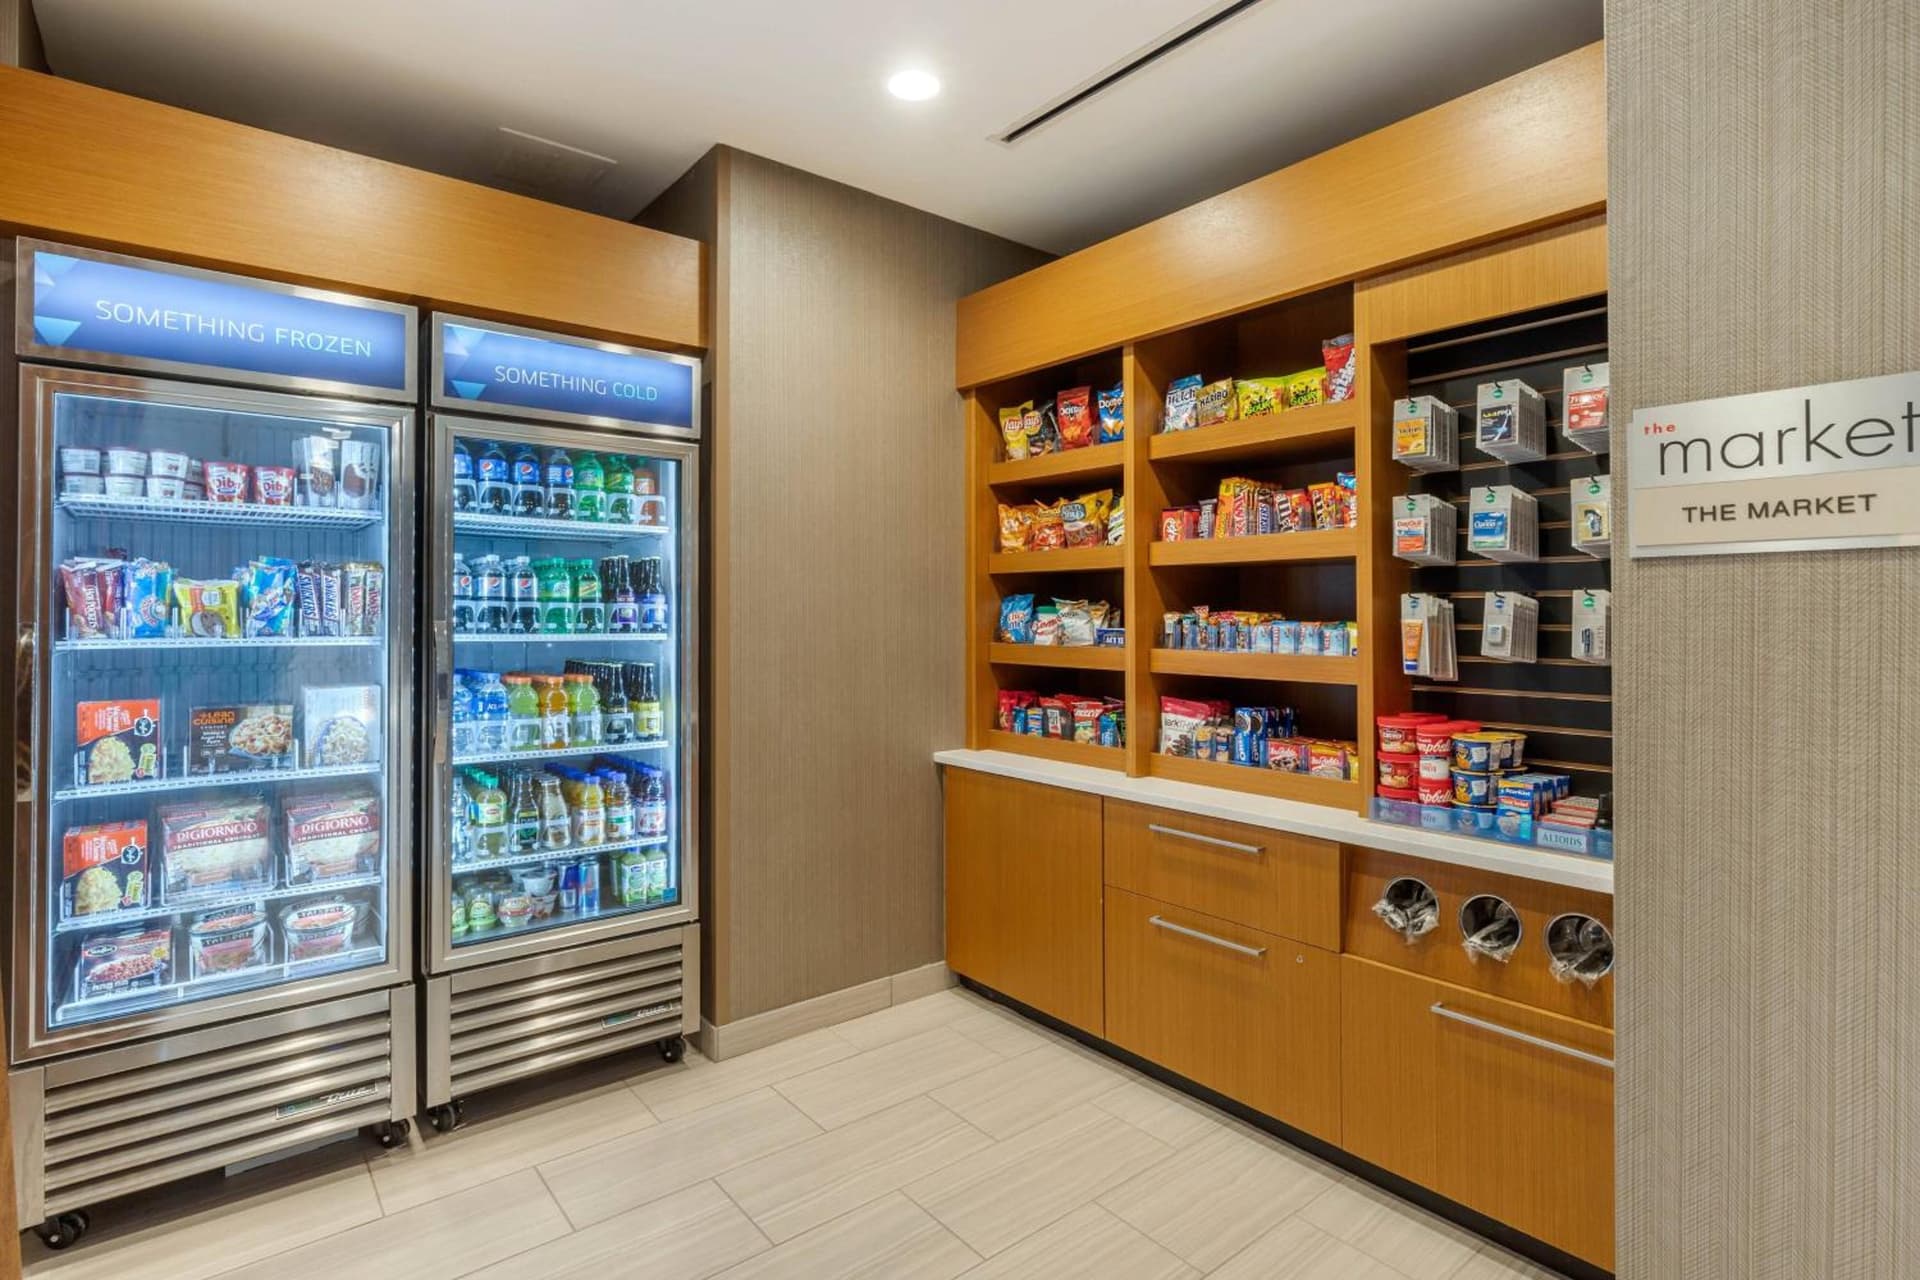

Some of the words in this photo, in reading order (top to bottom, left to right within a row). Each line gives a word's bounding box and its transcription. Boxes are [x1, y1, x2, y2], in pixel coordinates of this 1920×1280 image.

[95, 299, 265, 344] SOMETHING
[275, 328, 372, 358] FROZEN
[495, 365, 606, 396] SOMETHING
[612, 382, 658, 402] COLD
[1643, 422, 1676, 436] the
[1660, 399, 1920, 475] market
[1682, 503, 1737, 523] THE
[1748, 493, 1878, 519] MARKET
[302, 815, 370, 834] DIGIORNO
[1542, 832, 1583, 847] ALTOIDS
